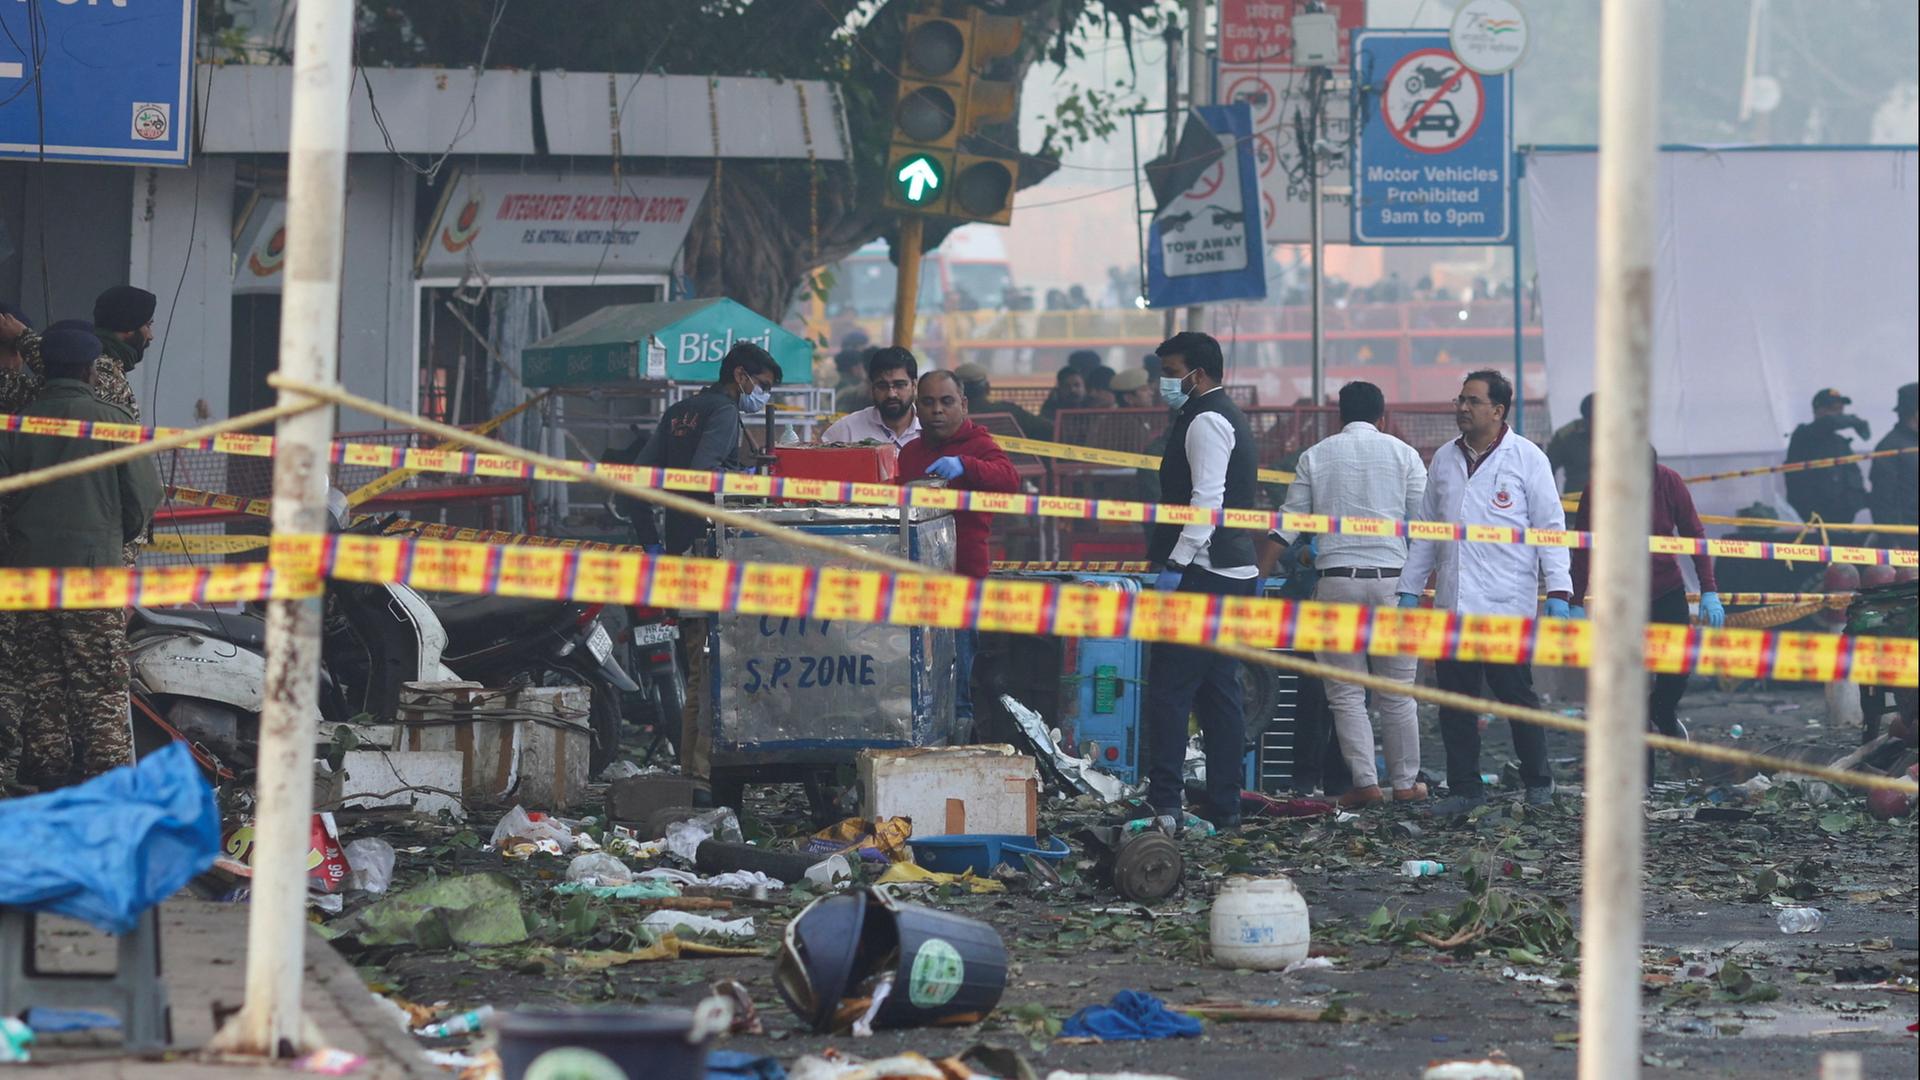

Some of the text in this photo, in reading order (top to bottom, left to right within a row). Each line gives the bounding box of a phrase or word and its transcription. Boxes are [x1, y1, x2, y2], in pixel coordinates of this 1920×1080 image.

[1225, 23, 1270, 42] Entry
[1368, 166, 1498, 181] Motor Vehicles
[1387, 187, 1479, 202] Prohibited
[496, 193, 573, 221] INTEGRATED
[642, 196, 689, 224] BOOTH
[1381, 208, 1485, 227] 9am to 9pm
[1166, 235, 1242, 254] TOW AWAY
[1185, 250, 1224, 264] ZONE
[417, 458, 444, 468] LINE
[477, 459, 519, 471] POLICE
[666, 474, 708, 485] POLICE
[796, 486, 822, 496] LINE
[855, 487, 895, 498] POLICE
[982, 499, 1009, 508] LINE
[1041, 500, 1082, 511] POLICE
[1168, 512, 1195, 521] LINE
[1226, 512, 1268, 522] POLICE
[1353, 524, 1379, 533] LINE
[1411, 524, 1451, 535] POLICE
[1537, 535, 1563, 544] LINE
[1720, 546, 1746, 555] LINE
[1776, 546, 1817, 557] POLICE
[743, 654, 876, 694] S.P. ZONE
